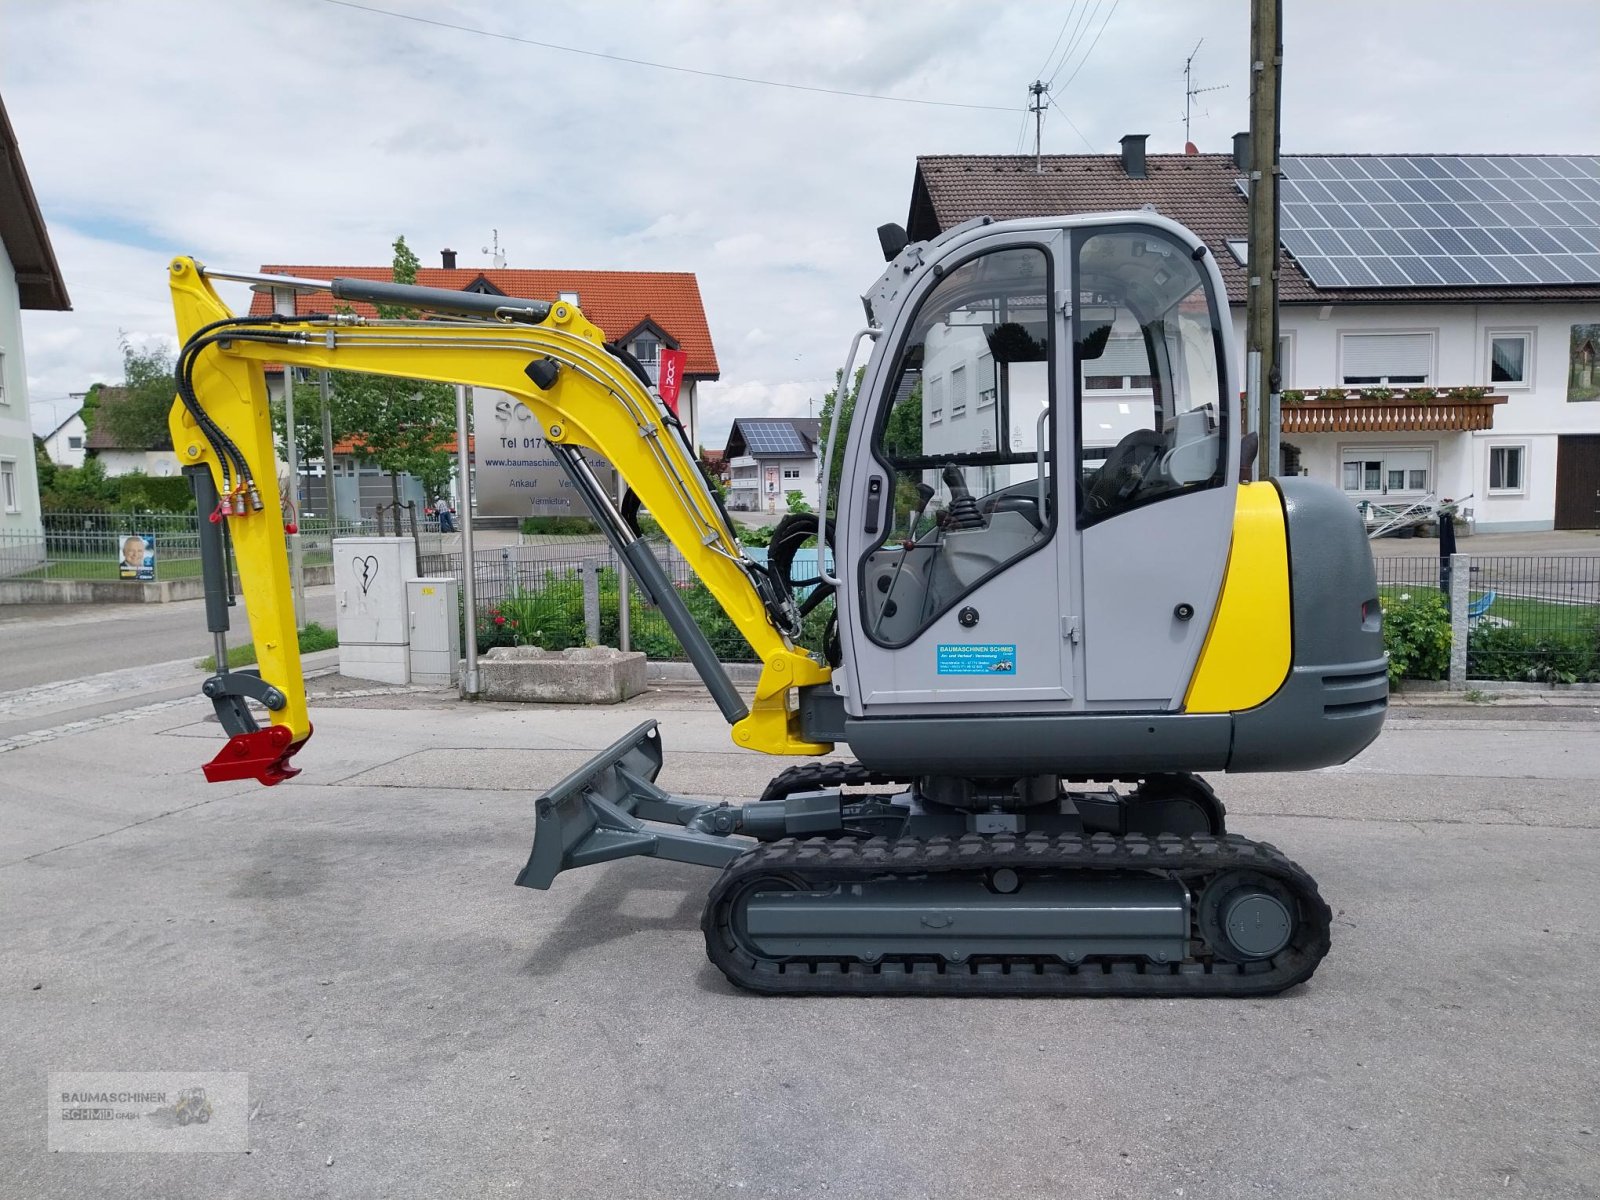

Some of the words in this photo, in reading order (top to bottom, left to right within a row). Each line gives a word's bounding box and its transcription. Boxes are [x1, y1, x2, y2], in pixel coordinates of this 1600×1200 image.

[495, 402, 531, 421] SC
[500, 437, 517, 449] Tel
[509, 479, 538, 488] Ankauf
[530, 497, 571, 506] Vermietung
